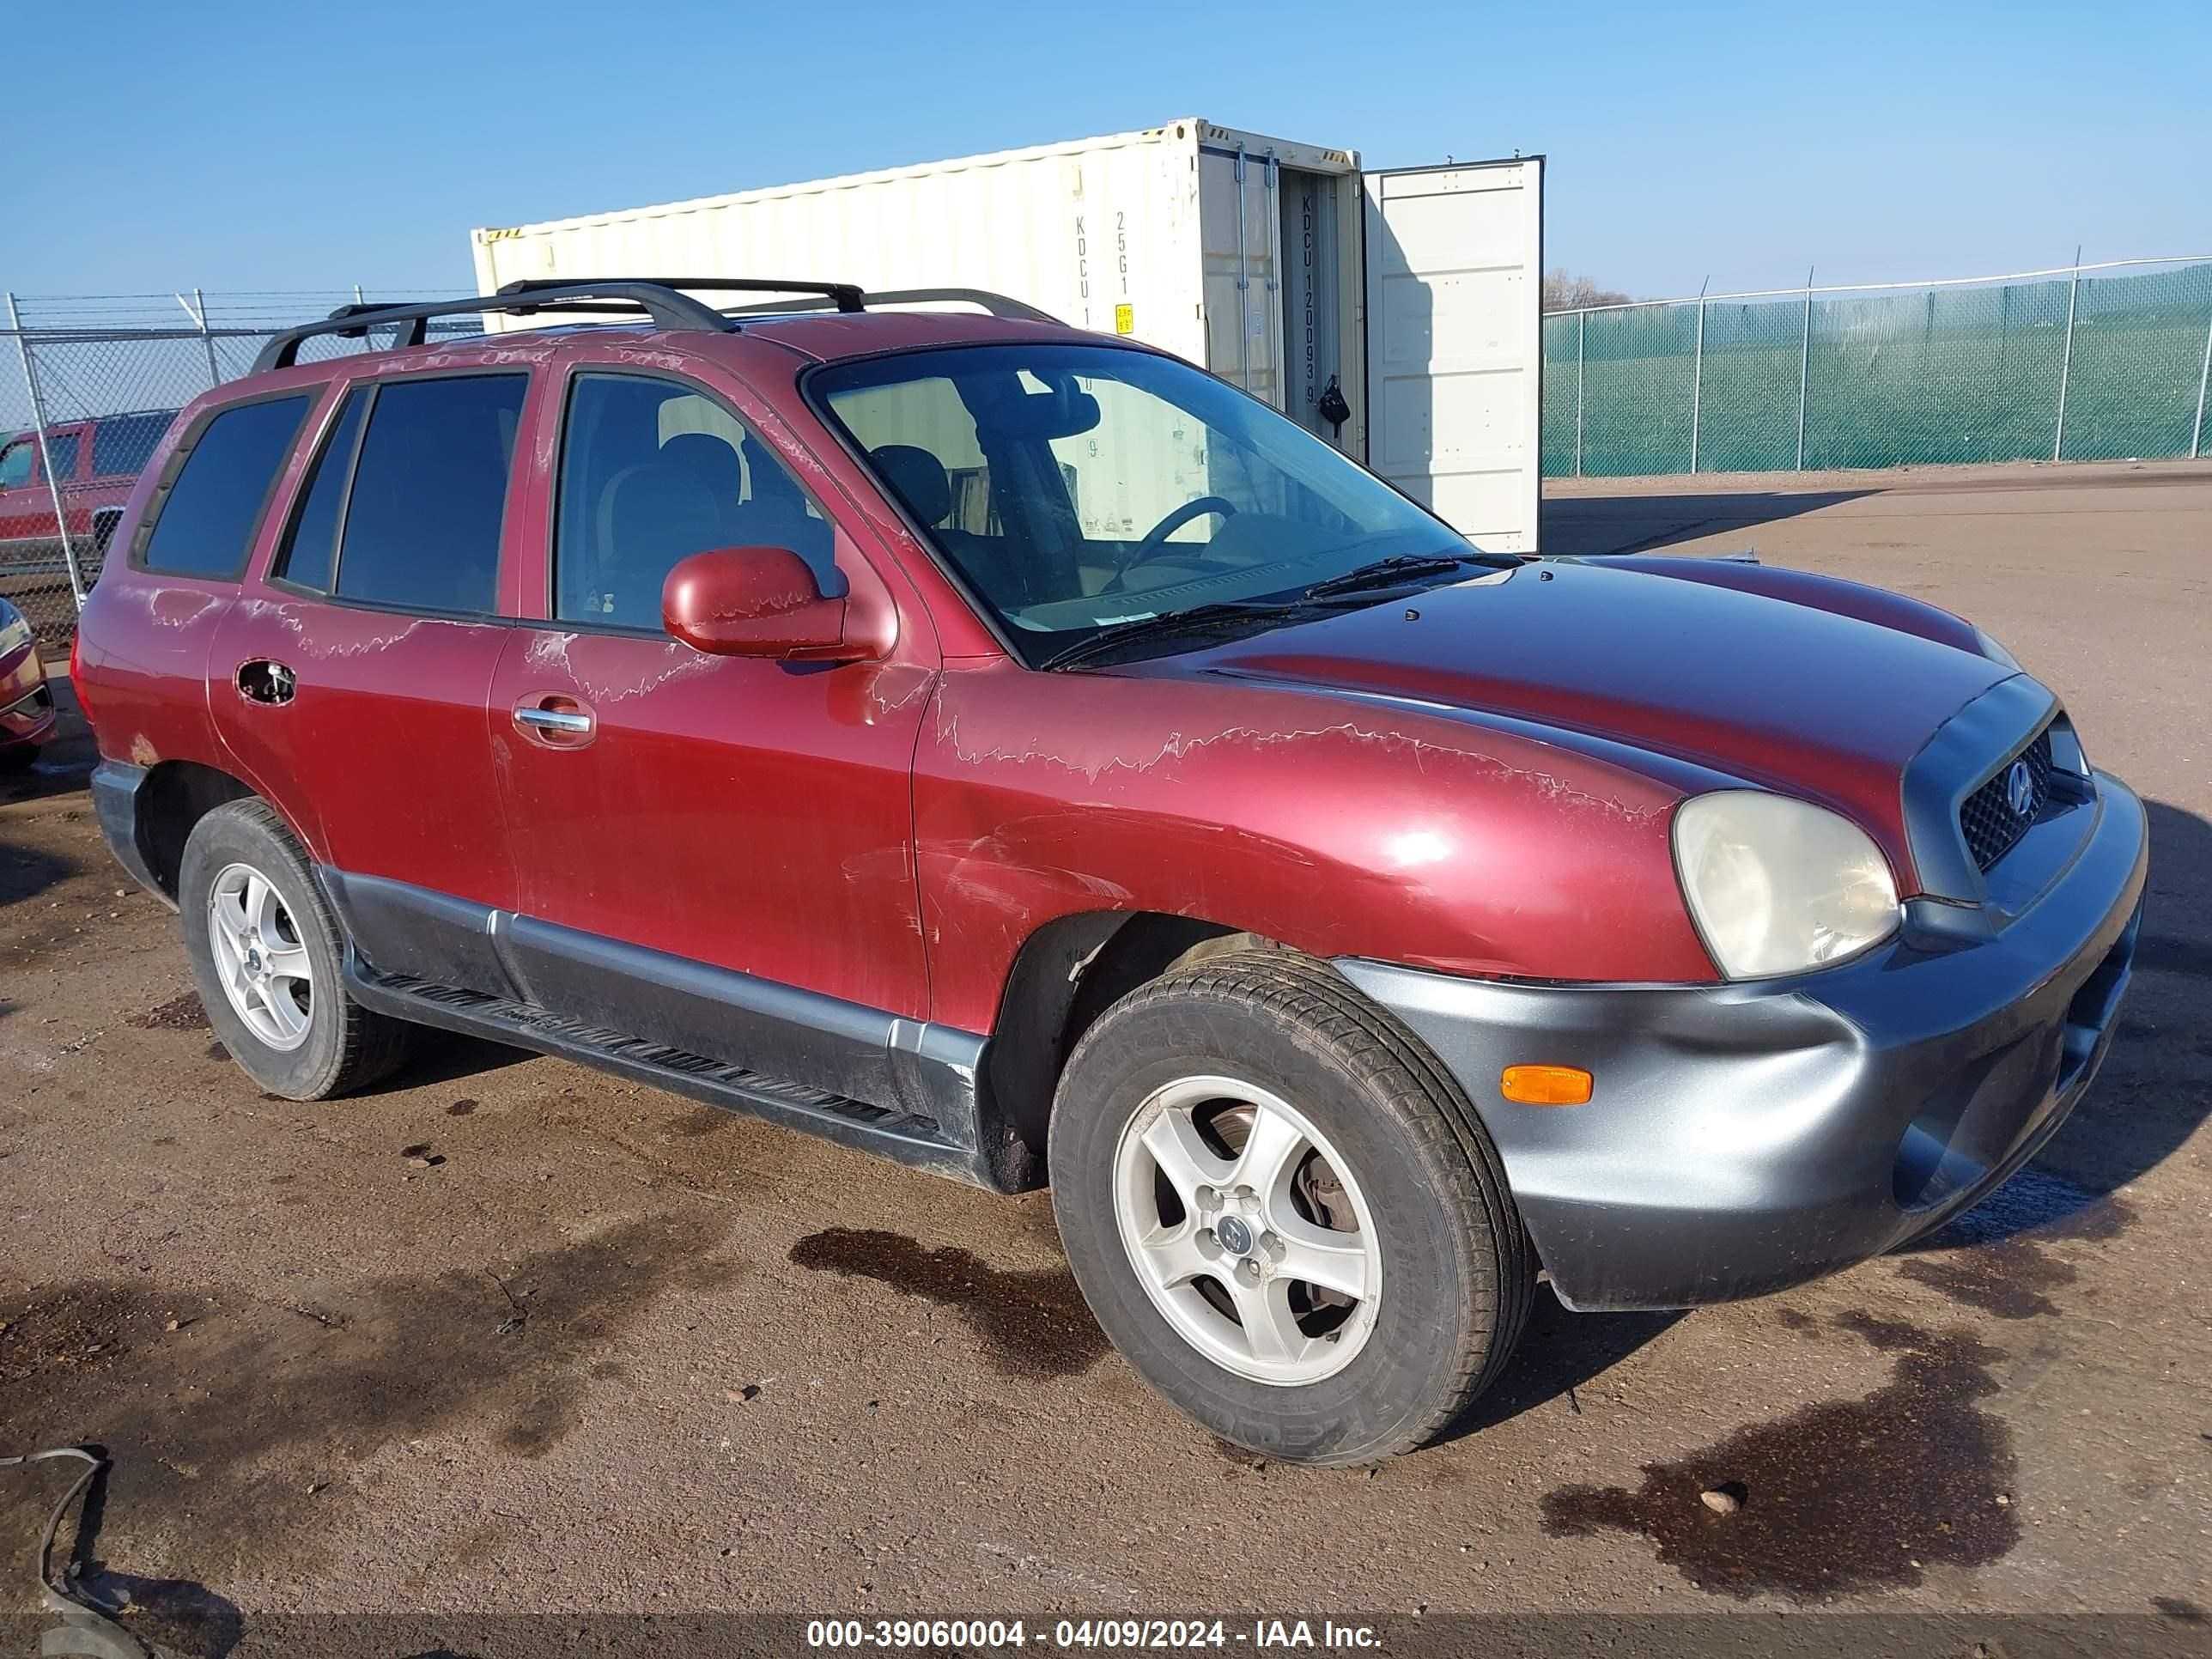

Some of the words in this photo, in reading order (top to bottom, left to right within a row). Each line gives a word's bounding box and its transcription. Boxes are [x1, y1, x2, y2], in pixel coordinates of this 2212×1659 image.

[1075, 216, 1089, 299] KDCU
[1116, 211, 1128, 295] 25G1
[1302, 195, 1312, 267] KDCU
[1304, 273, 1314, 380] 120093
